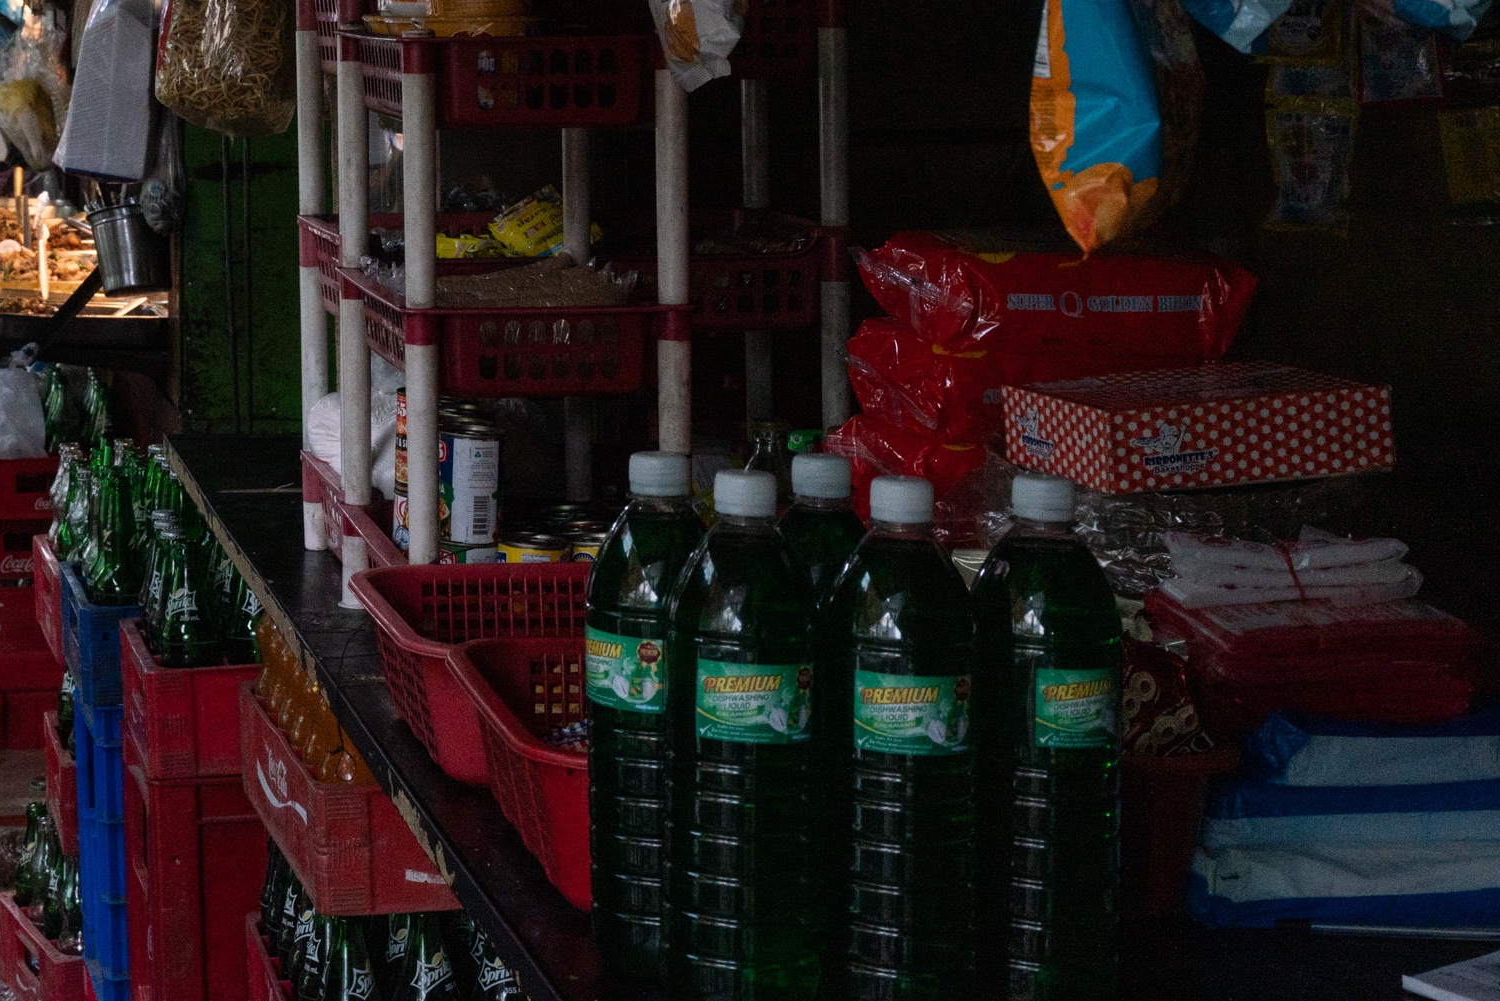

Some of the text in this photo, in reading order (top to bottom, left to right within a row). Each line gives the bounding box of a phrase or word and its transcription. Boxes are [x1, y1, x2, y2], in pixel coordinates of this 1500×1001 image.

[1007, 293, 1056, 311] SUPER
[1059, 291, 1084, 318] Q
[1087, 295, 1154, 313] GOLDEN
[1154, 463, 1205, 474] Bakeshoppe
[703, 674, 782, 694] PREMIUM
[861, 686, 939, 705] PREMIUM
